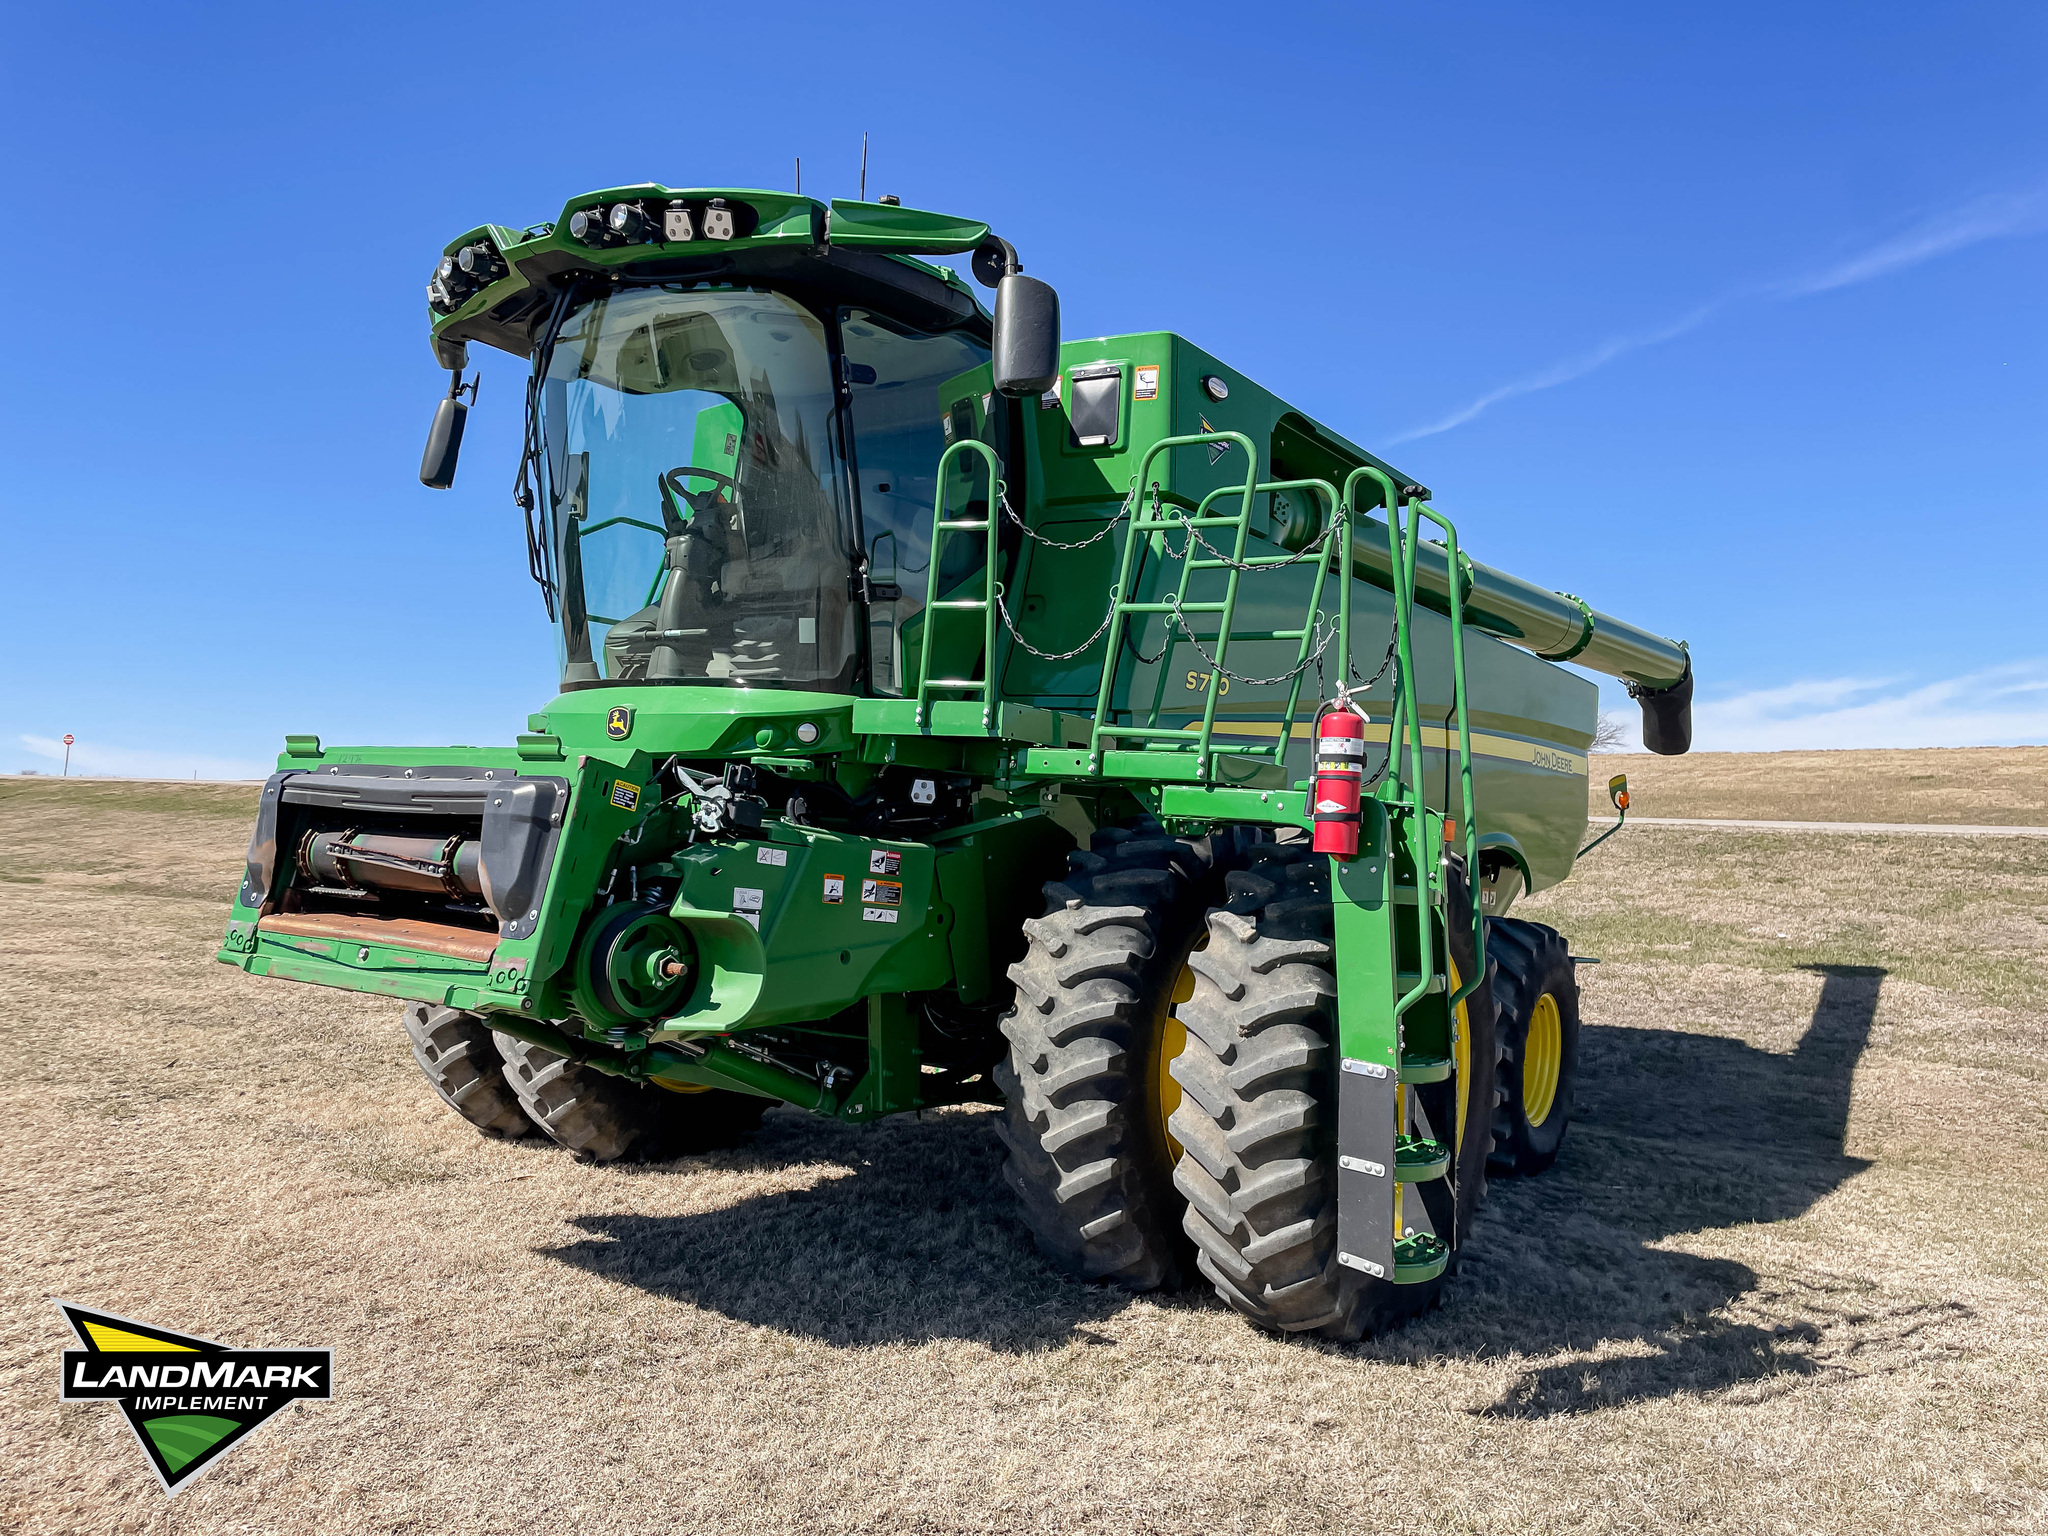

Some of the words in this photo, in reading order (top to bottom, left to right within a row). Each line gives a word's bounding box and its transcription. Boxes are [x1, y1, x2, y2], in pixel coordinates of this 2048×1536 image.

[1185, 670, 1230, 696] S70
[1532, 747, 1551, 767] JOHN
[1551, 752, 1573, 772] DEERE
